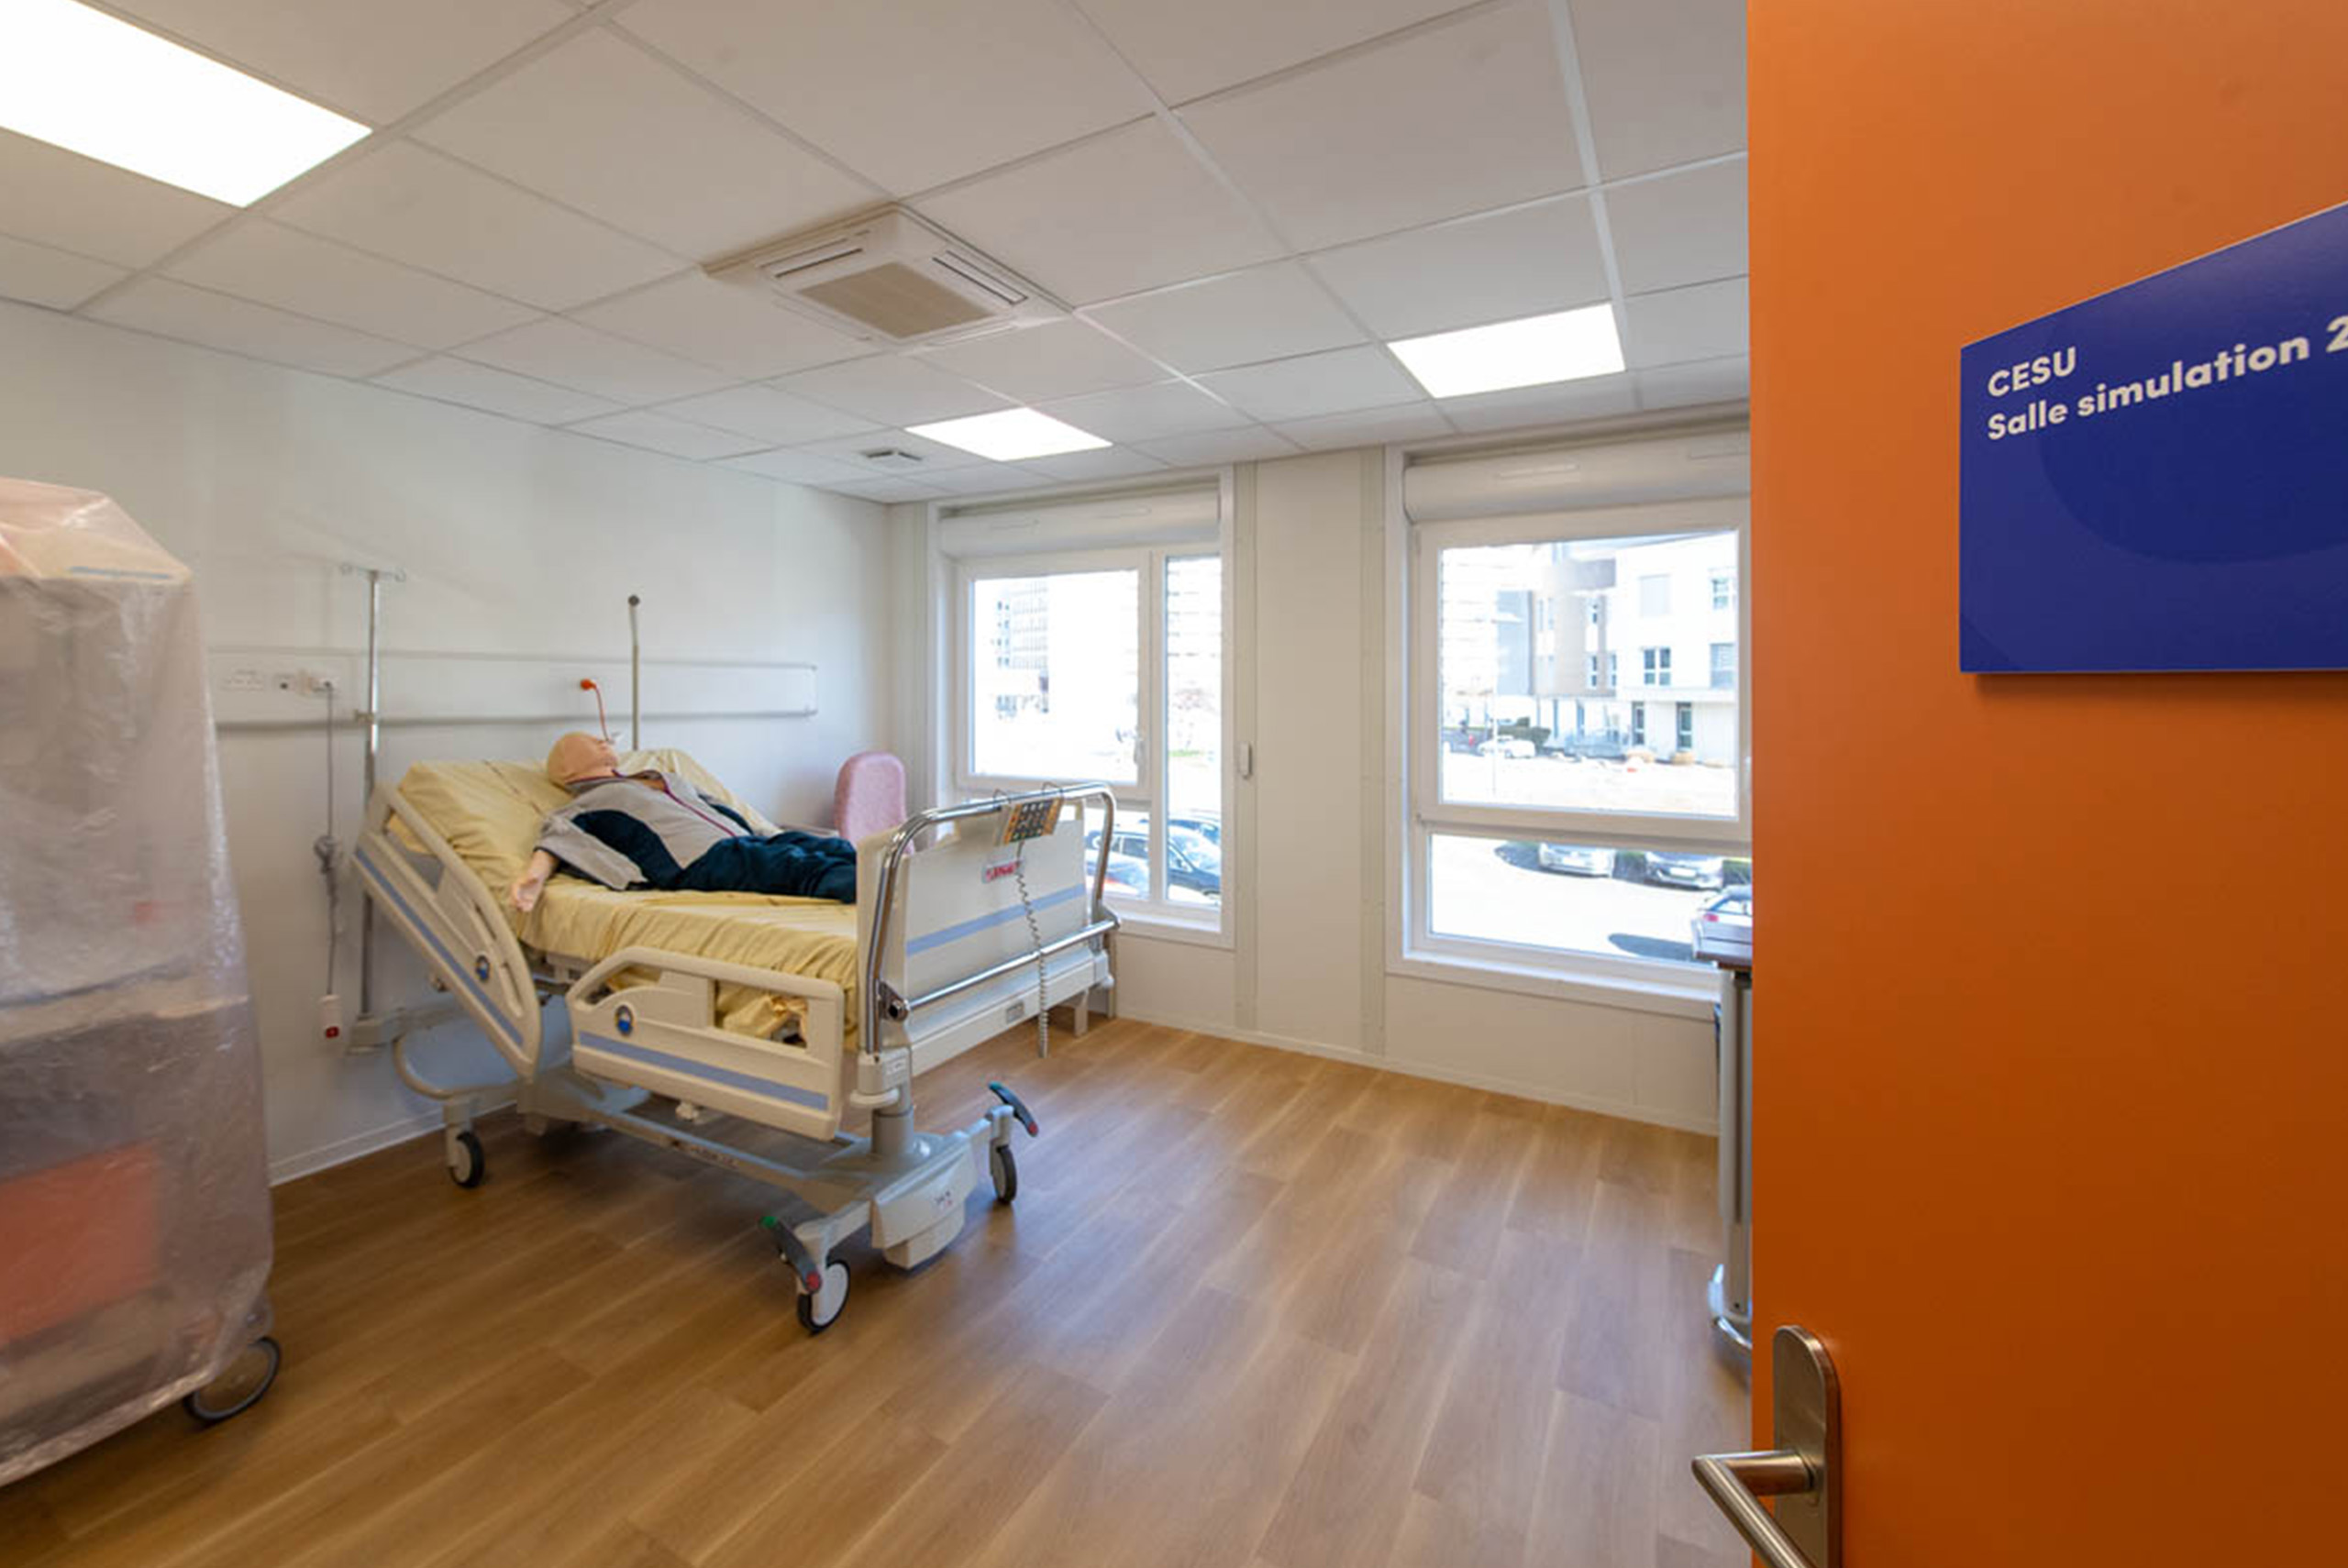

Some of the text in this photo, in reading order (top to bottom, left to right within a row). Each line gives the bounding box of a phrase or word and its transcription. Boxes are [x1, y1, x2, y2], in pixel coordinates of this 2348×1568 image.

[1988, 347, 2077, 397] CESU
[1988, 315, 2348, 440] Salle simulation 2
